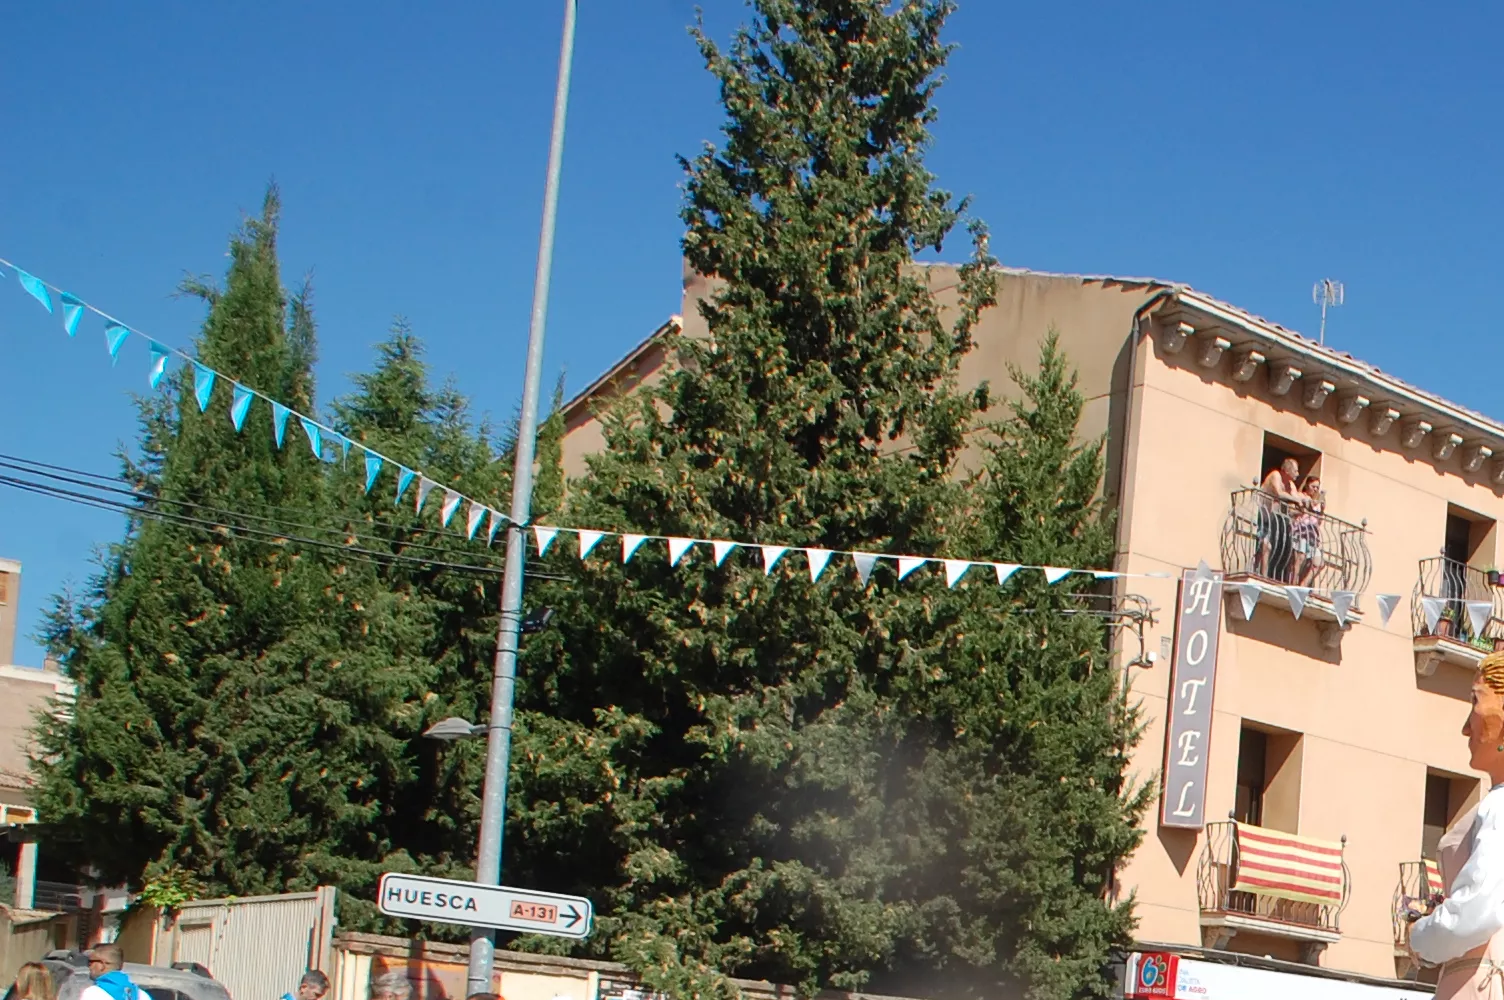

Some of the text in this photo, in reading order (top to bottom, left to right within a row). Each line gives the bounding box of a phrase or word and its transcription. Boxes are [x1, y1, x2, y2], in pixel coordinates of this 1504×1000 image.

[1172, 579, 1214, 818] HOTEL
[387, 886, 556, 921] HUESCA A-131
